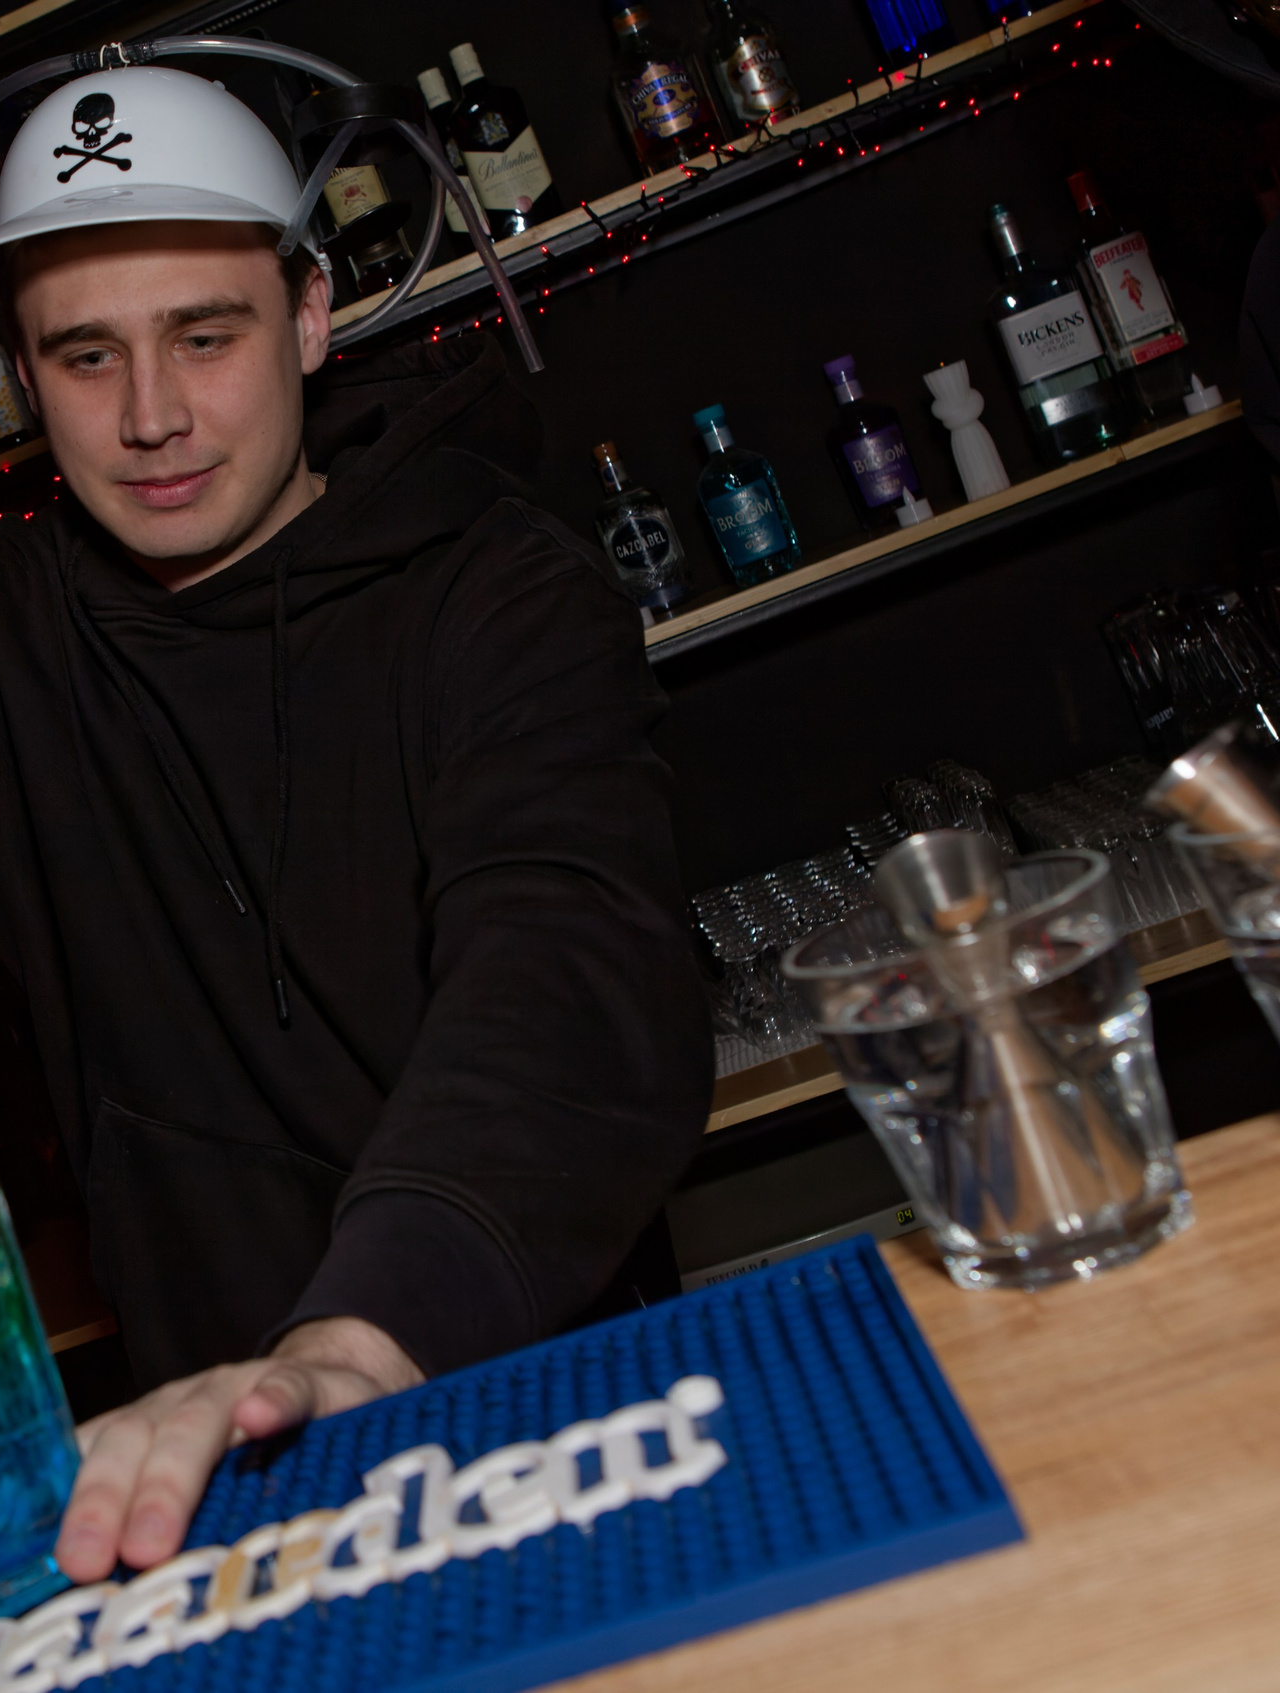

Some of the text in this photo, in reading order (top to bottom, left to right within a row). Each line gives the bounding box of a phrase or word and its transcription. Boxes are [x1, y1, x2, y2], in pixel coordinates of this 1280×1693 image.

[1093, 235, 1146, 269] BEEFEATER
[1017, 311, 1084, 347] BICKENS
[852, 441, 907, 476] BOM
[616, 529, 667, 561] CAZCABEL
[897, 1207, 913, 1224] 04
